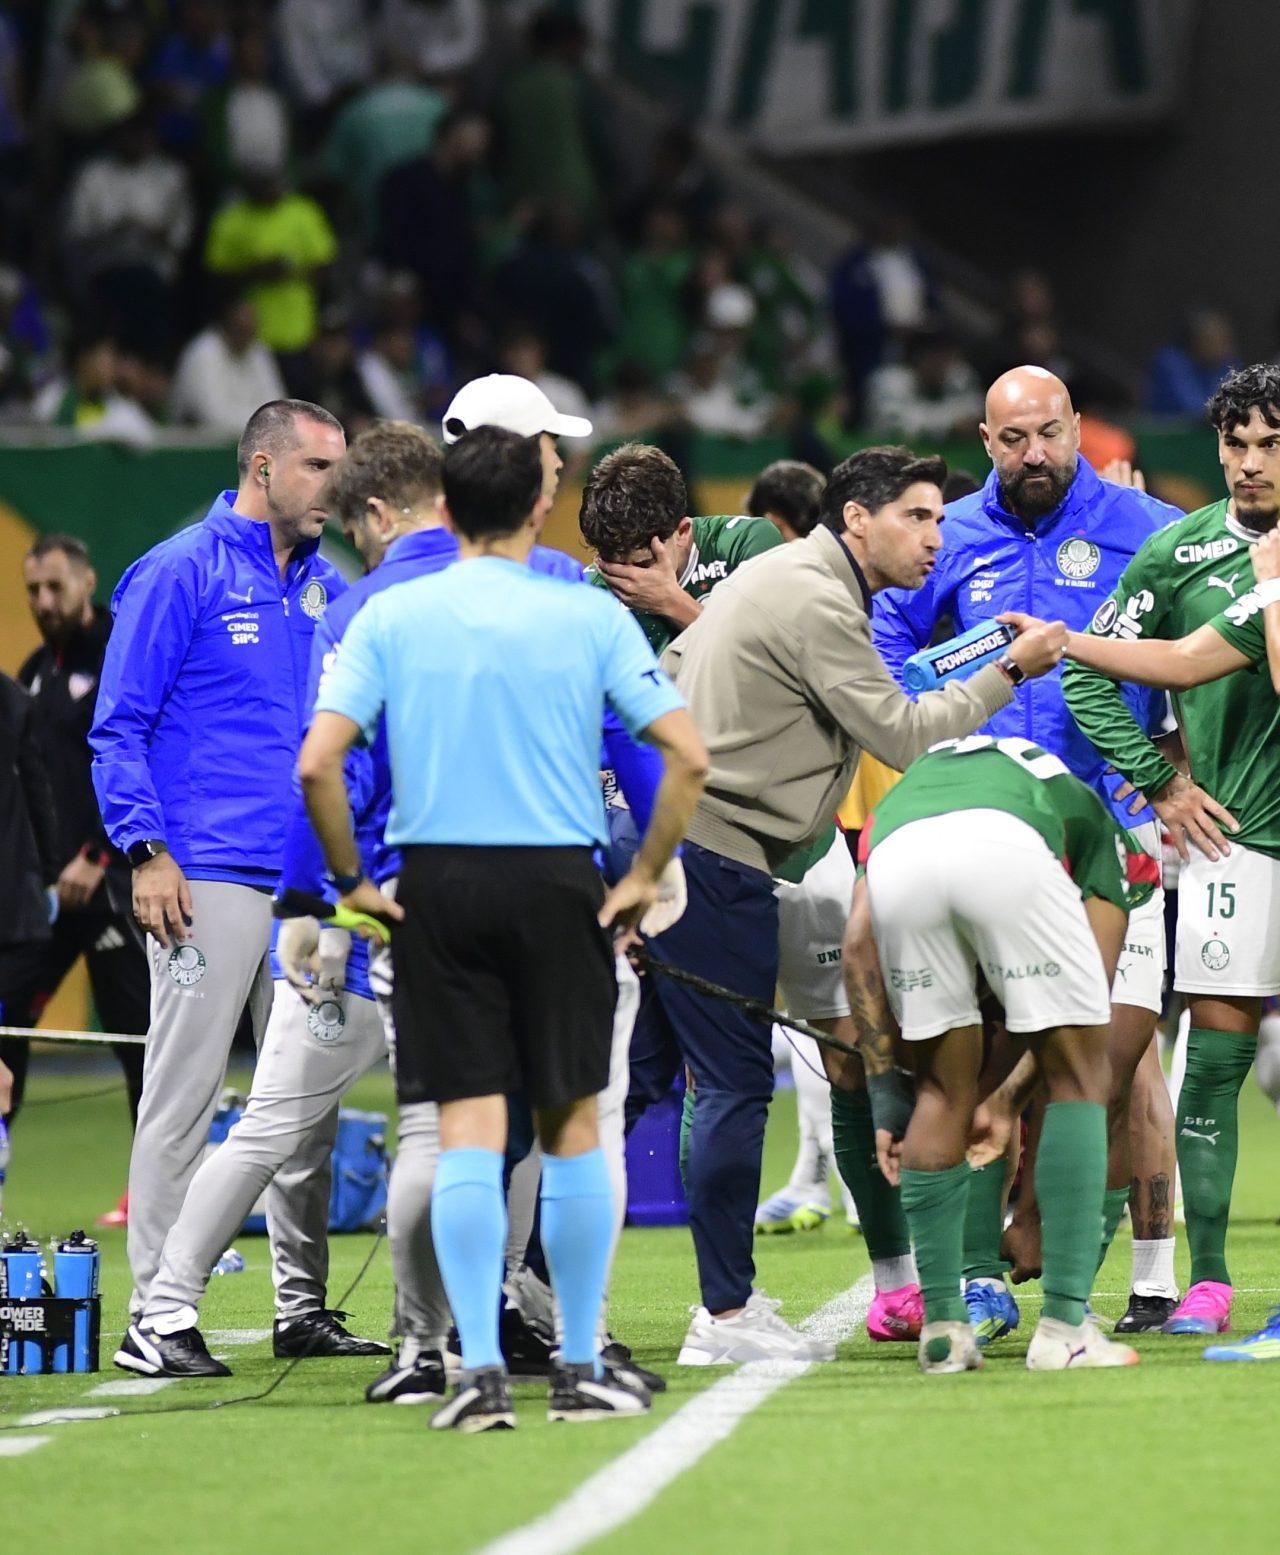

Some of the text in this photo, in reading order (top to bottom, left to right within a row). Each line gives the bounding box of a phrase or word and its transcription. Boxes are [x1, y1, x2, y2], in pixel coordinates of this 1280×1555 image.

[1174, 538, 1239, 563] CIMED
[1059, 554, 1098, 577] PALMEIRAS
[227, 622, 259, 632] CIMED
[935, 631, 1007, 674] POWERADE
[1207, 883, 1236, 918] 15
[13, 1320, 47, 1332] ADE
